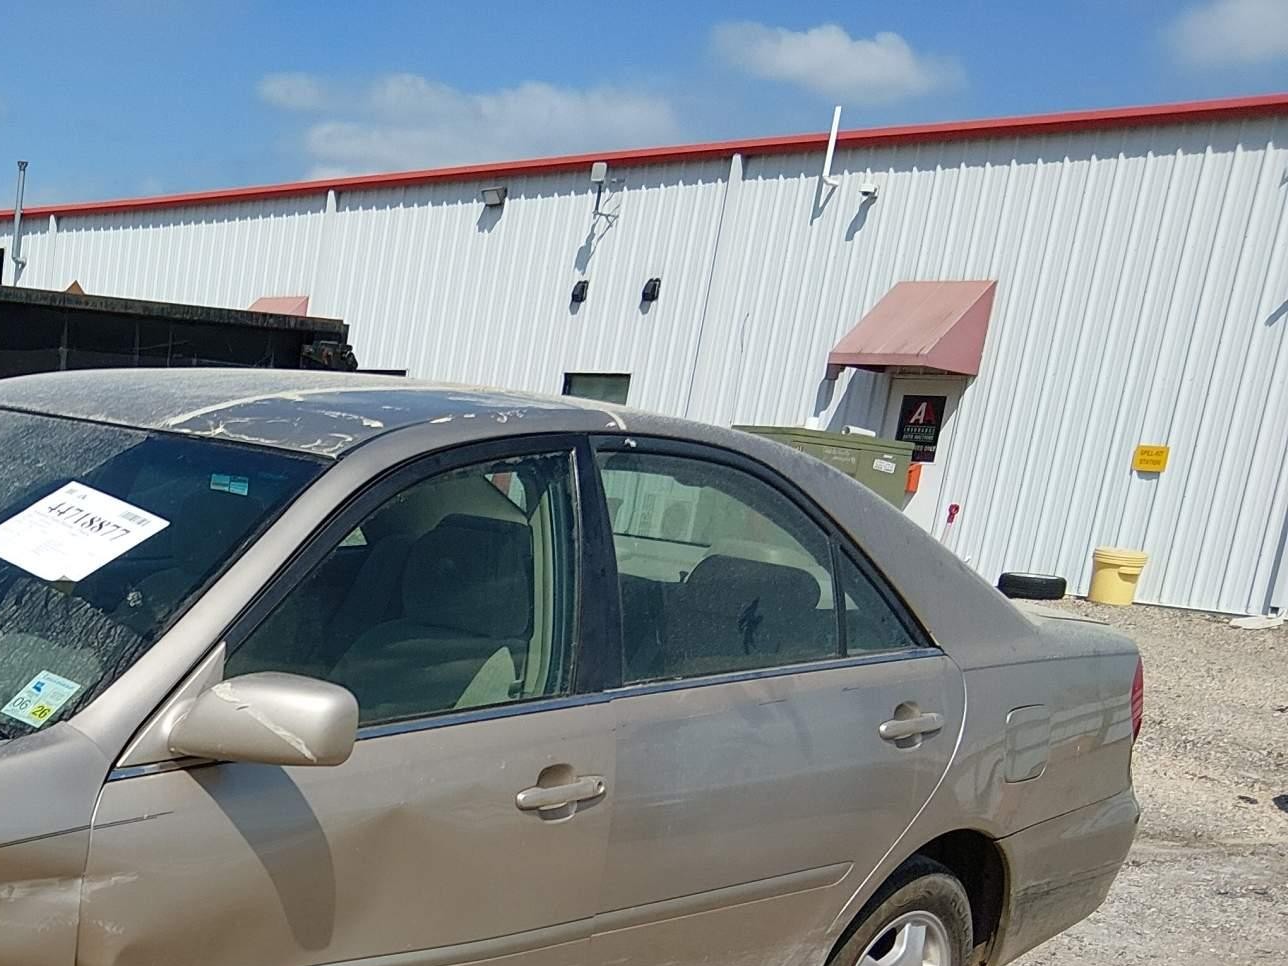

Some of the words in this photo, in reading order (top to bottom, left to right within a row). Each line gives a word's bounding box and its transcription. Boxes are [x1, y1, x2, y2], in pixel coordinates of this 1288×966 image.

[48, 502, 130, 541] 44718877
[12, 697, 31, 711] 06
[31, 705, 51, 719] 26
